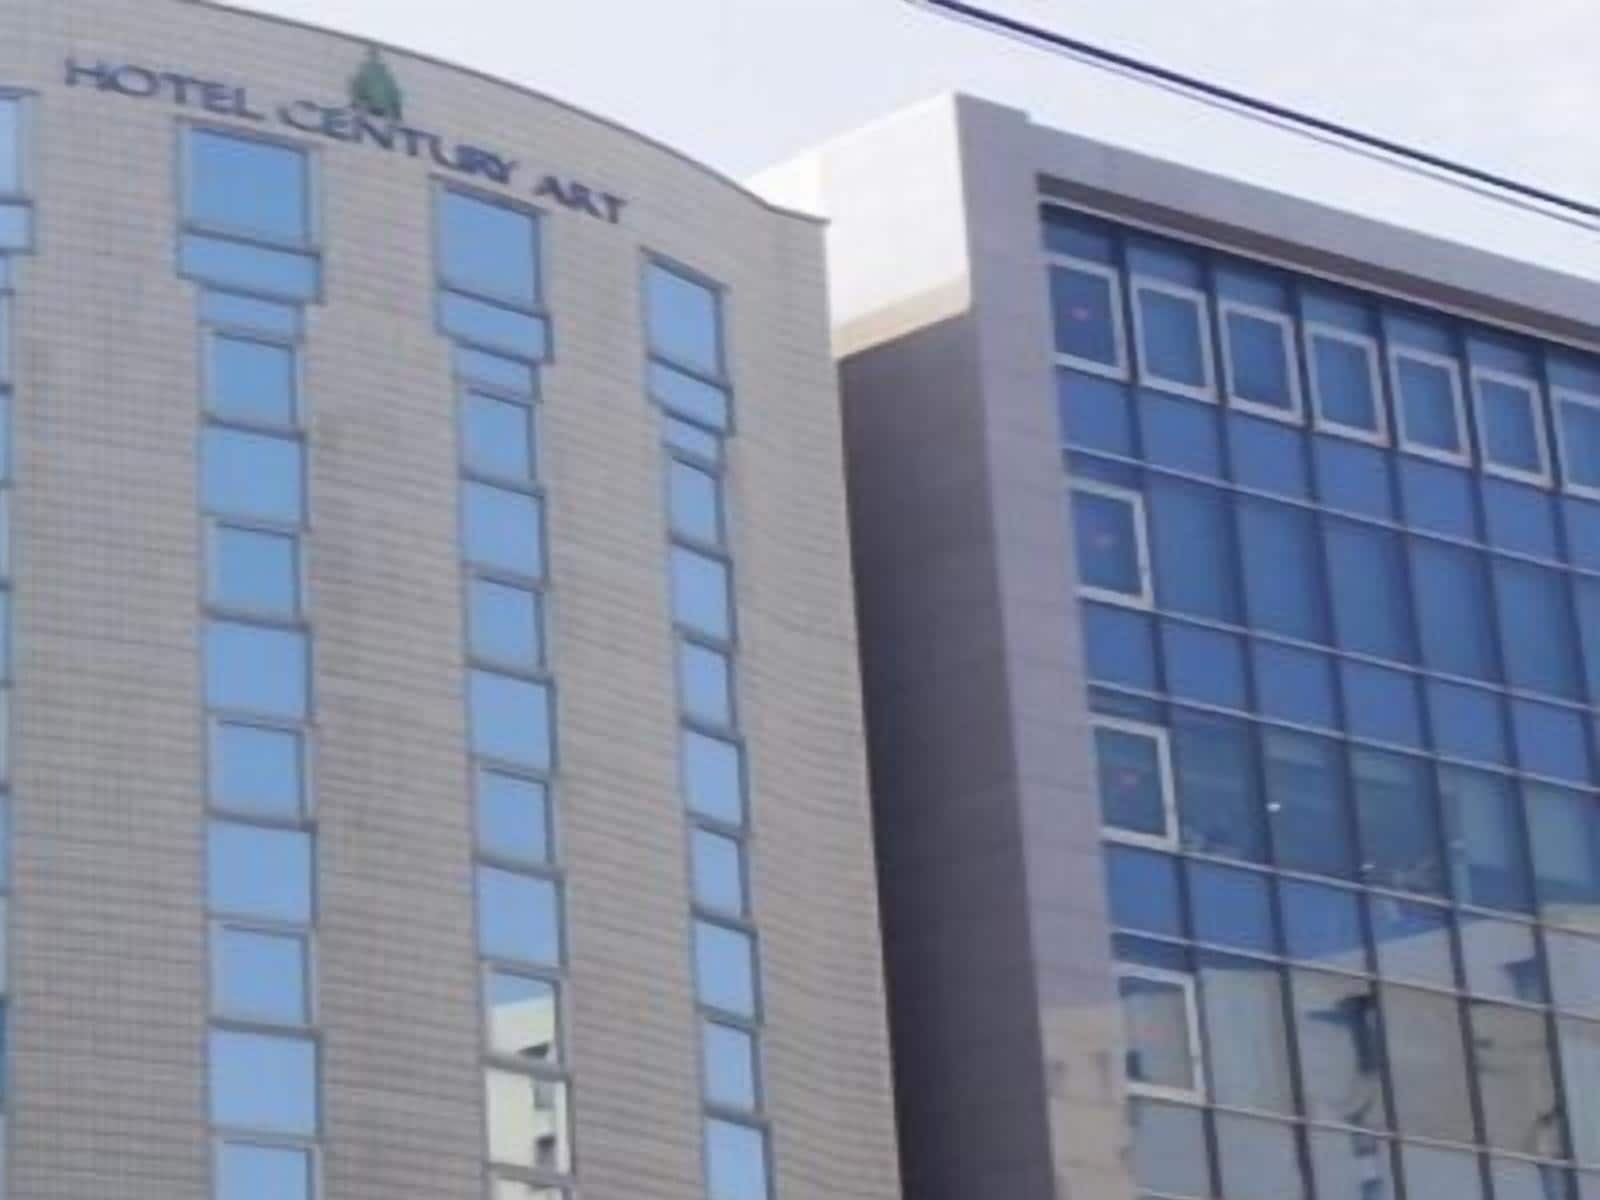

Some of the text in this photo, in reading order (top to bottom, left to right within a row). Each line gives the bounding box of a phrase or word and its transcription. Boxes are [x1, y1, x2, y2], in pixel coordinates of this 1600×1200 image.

[64, 57, 627, 225] HOTEL CENTURY ART
